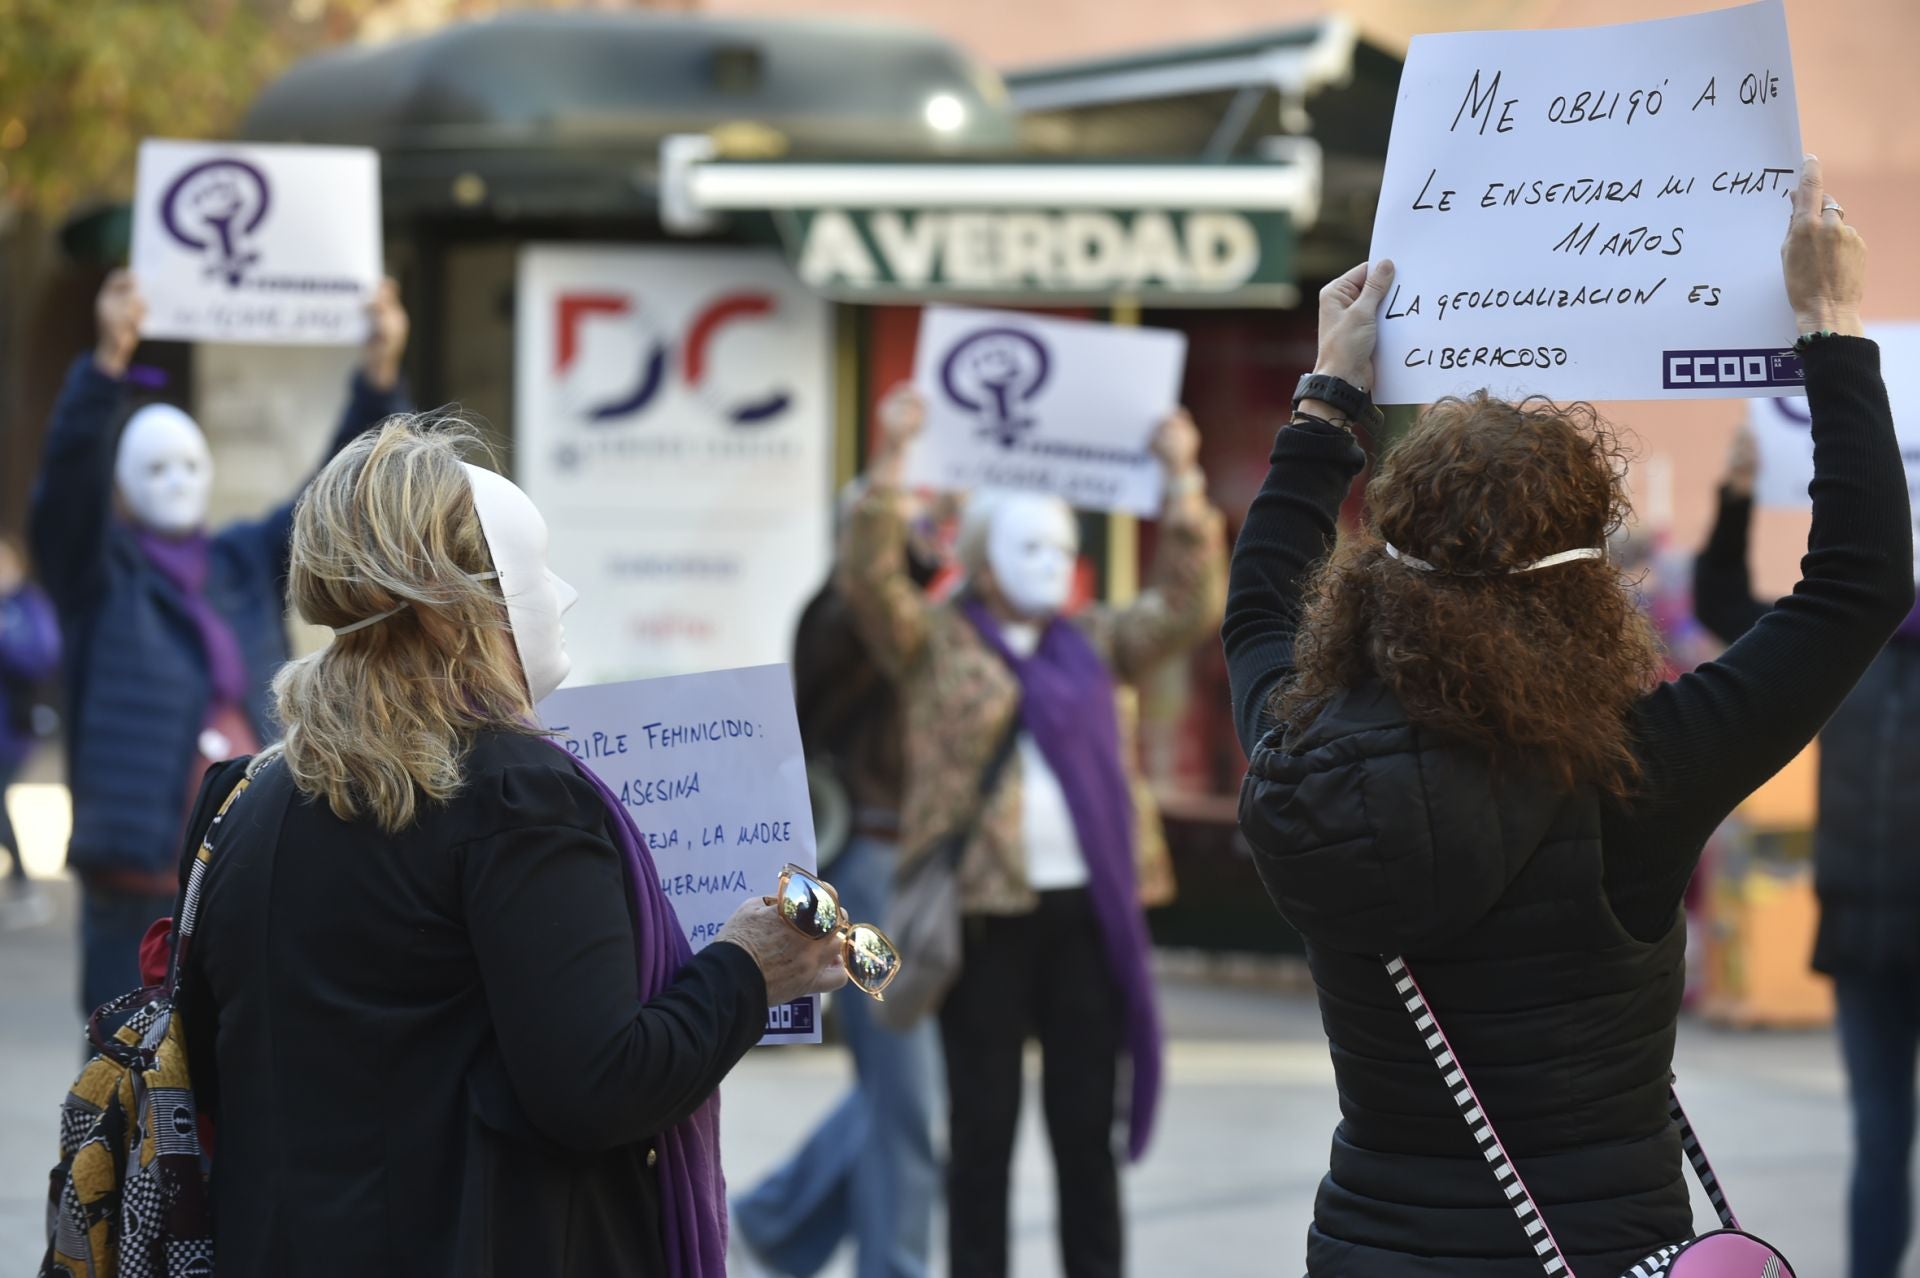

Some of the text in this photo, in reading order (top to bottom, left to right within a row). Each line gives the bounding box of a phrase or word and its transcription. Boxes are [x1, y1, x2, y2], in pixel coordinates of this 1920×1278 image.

[1692, 76, 1716, 111] A
[1739, 69, 1780, 106] QUE
[1411, 168, 1795, 212] LE ENSEÑARA MI CHAT,
[1384, 284, 1420, 319] LA
[1687, 285, 1722, 307] ES
[1404, 346, 1568, 370] CIBERACOSO
[1669, 355, 1768, 383] CCOO
[620, 772, 700, 807] ASESINA
[702, 824, 725, 847] LA
[736, 820, 792, 846] MADRE
